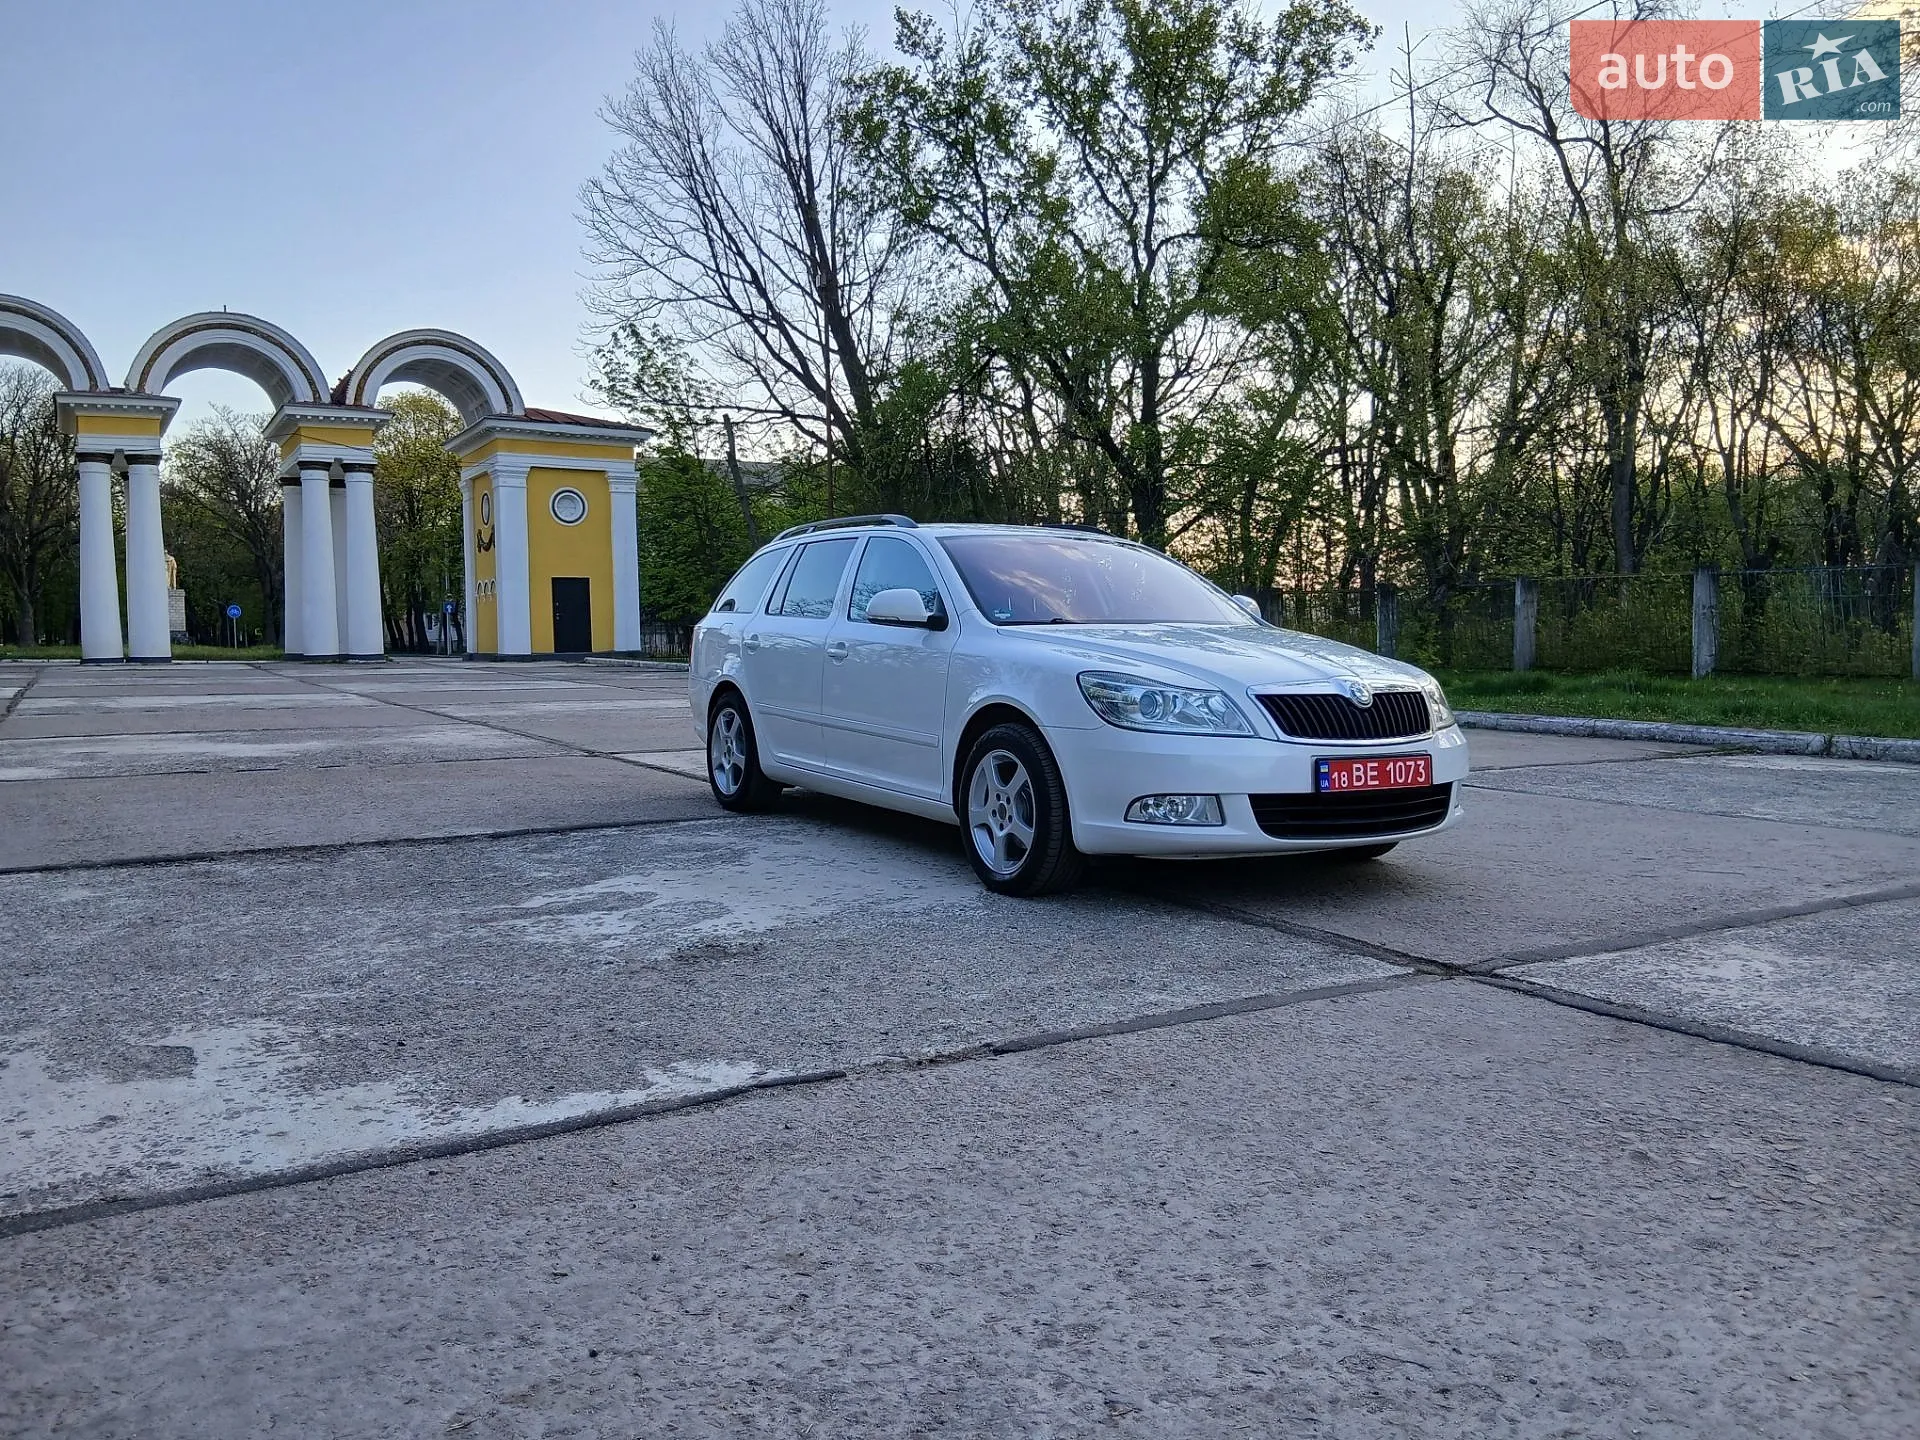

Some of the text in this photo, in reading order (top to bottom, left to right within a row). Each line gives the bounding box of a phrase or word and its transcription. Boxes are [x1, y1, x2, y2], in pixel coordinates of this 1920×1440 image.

[1332, 760, 1426, 788] 18 BE 1073
[1320, 779, 1329, 788] UA
